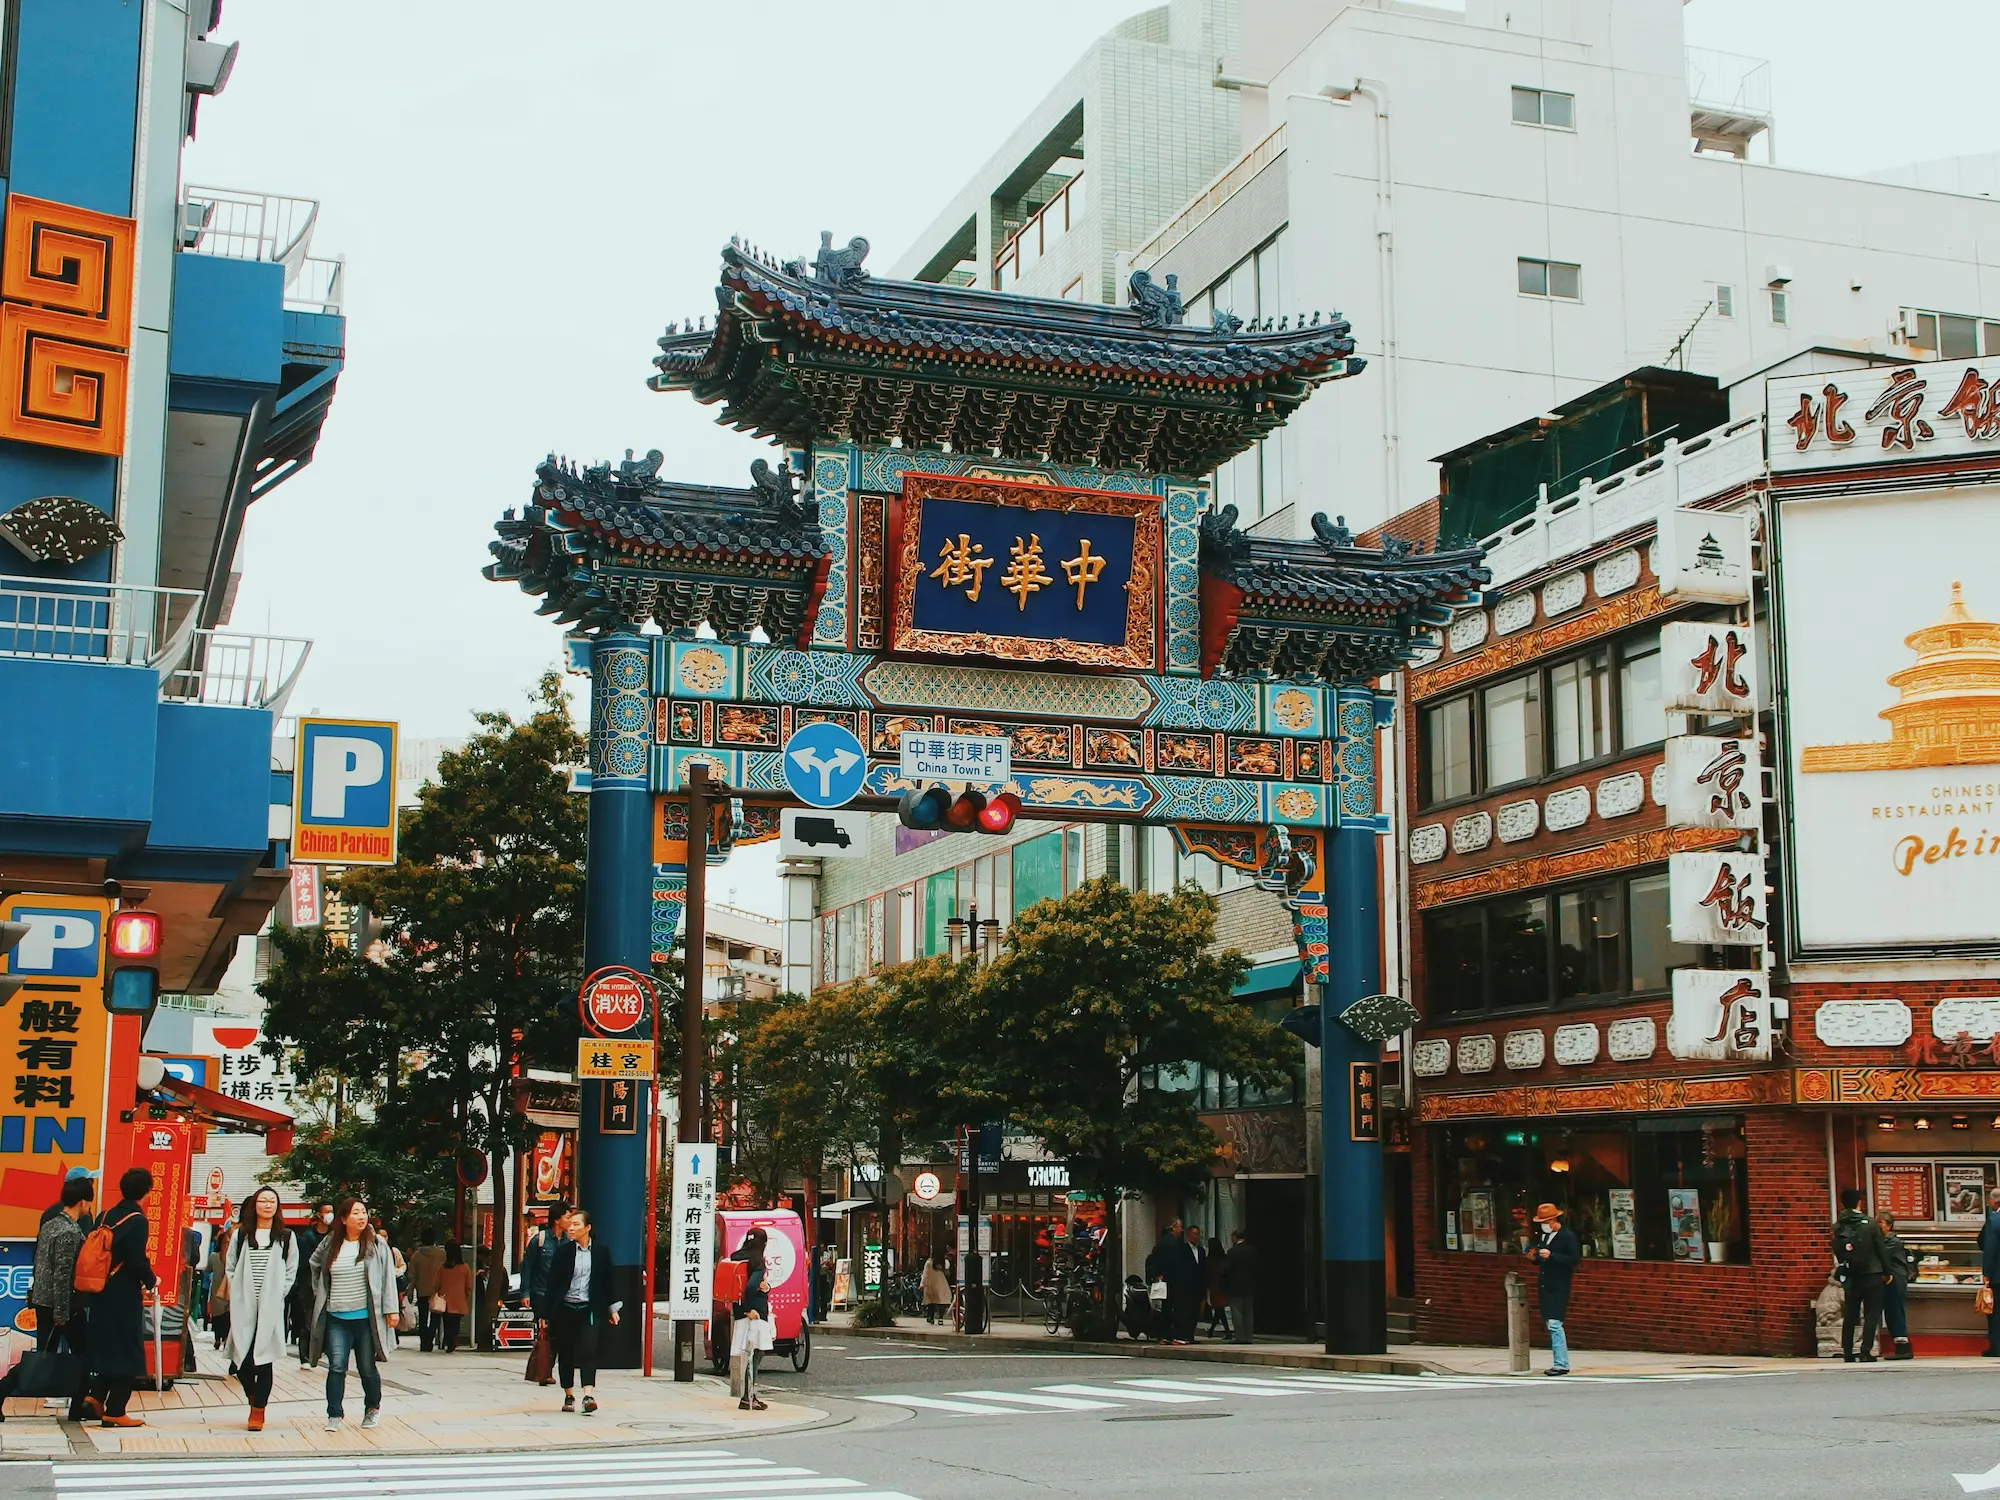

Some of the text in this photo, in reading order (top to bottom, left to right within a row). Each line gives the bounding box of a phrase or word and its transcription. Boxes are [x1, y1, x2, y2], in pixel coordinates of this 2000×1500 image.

[909, 738, 1003, 763] 中華街東門
[917, 761, 995, 777] China Town E.
[311, 735, 384, 818] P
[1872, 801, 1994, 819] RESTAURANT
[300, 830, 390, 857] China Parking
[1690, 630, 1767, 1050] 北京飯店
[17, 914, 95, 970] P
[595, 993, 639, 1014] 消火栓
[13, 983, 81, 1109] 一般有料
[1358, 1069, 1374, 1131] 朝陽門
[1, 1115, 86, 1154] IN
